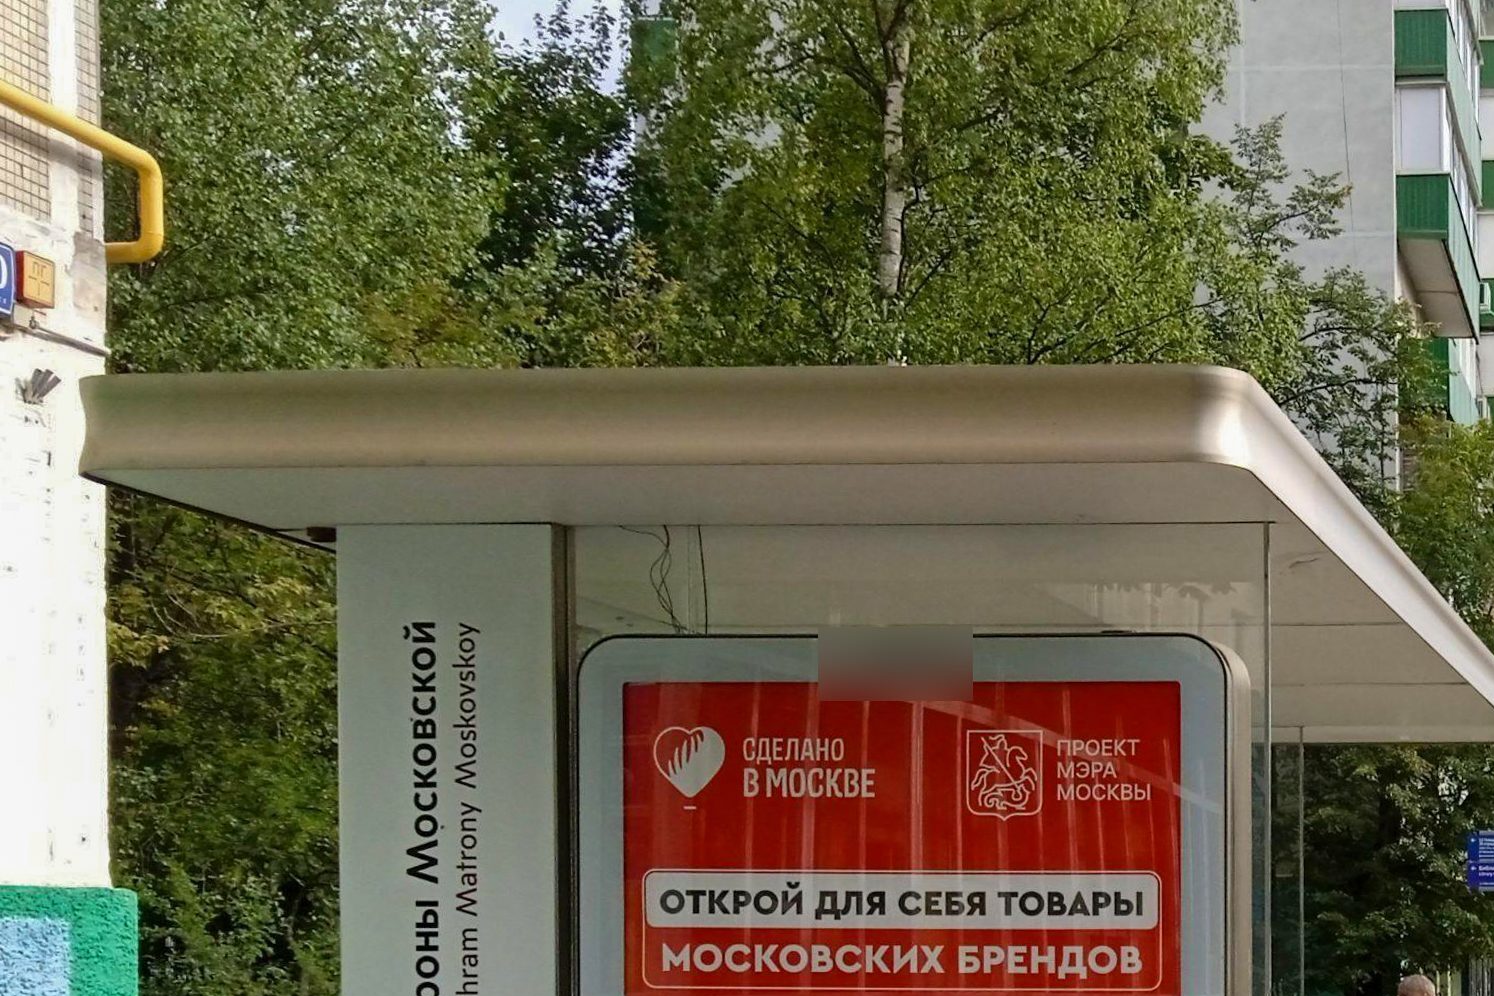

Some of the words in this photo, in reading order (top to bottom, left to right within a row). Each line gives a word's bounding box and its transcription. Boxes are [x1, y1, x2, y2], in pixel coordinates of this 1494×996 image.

[452, 622, 481, 789] Moskovskoy
[402, 621, 439, 884] Московской
[742, 737, 845, 765] СДЕЛАНО
[1056, 738, 1141, 757] ПРОЕКТ
[743, 767, 760, 798] В
[765, 767, 876, 798] МОСКВЕ
[1056, 761, 1118, 779] МЭРА
[1056, 783, 1151, 801] МОСКВЫ
[455, 801, 482, 917] Matrony
[659, 880, 804, 916] ОТКРОЙ
[814, 889, 887, 921] ДЛЯ
[897, 890, 987, 917] СЕБЯ
[997, 891, 1144, 917] ТОВАРЫ
[661, 942, 946, 974] МОСКОВСКИХ
[957, 944, 1144, 980] БРЕНДОВ
